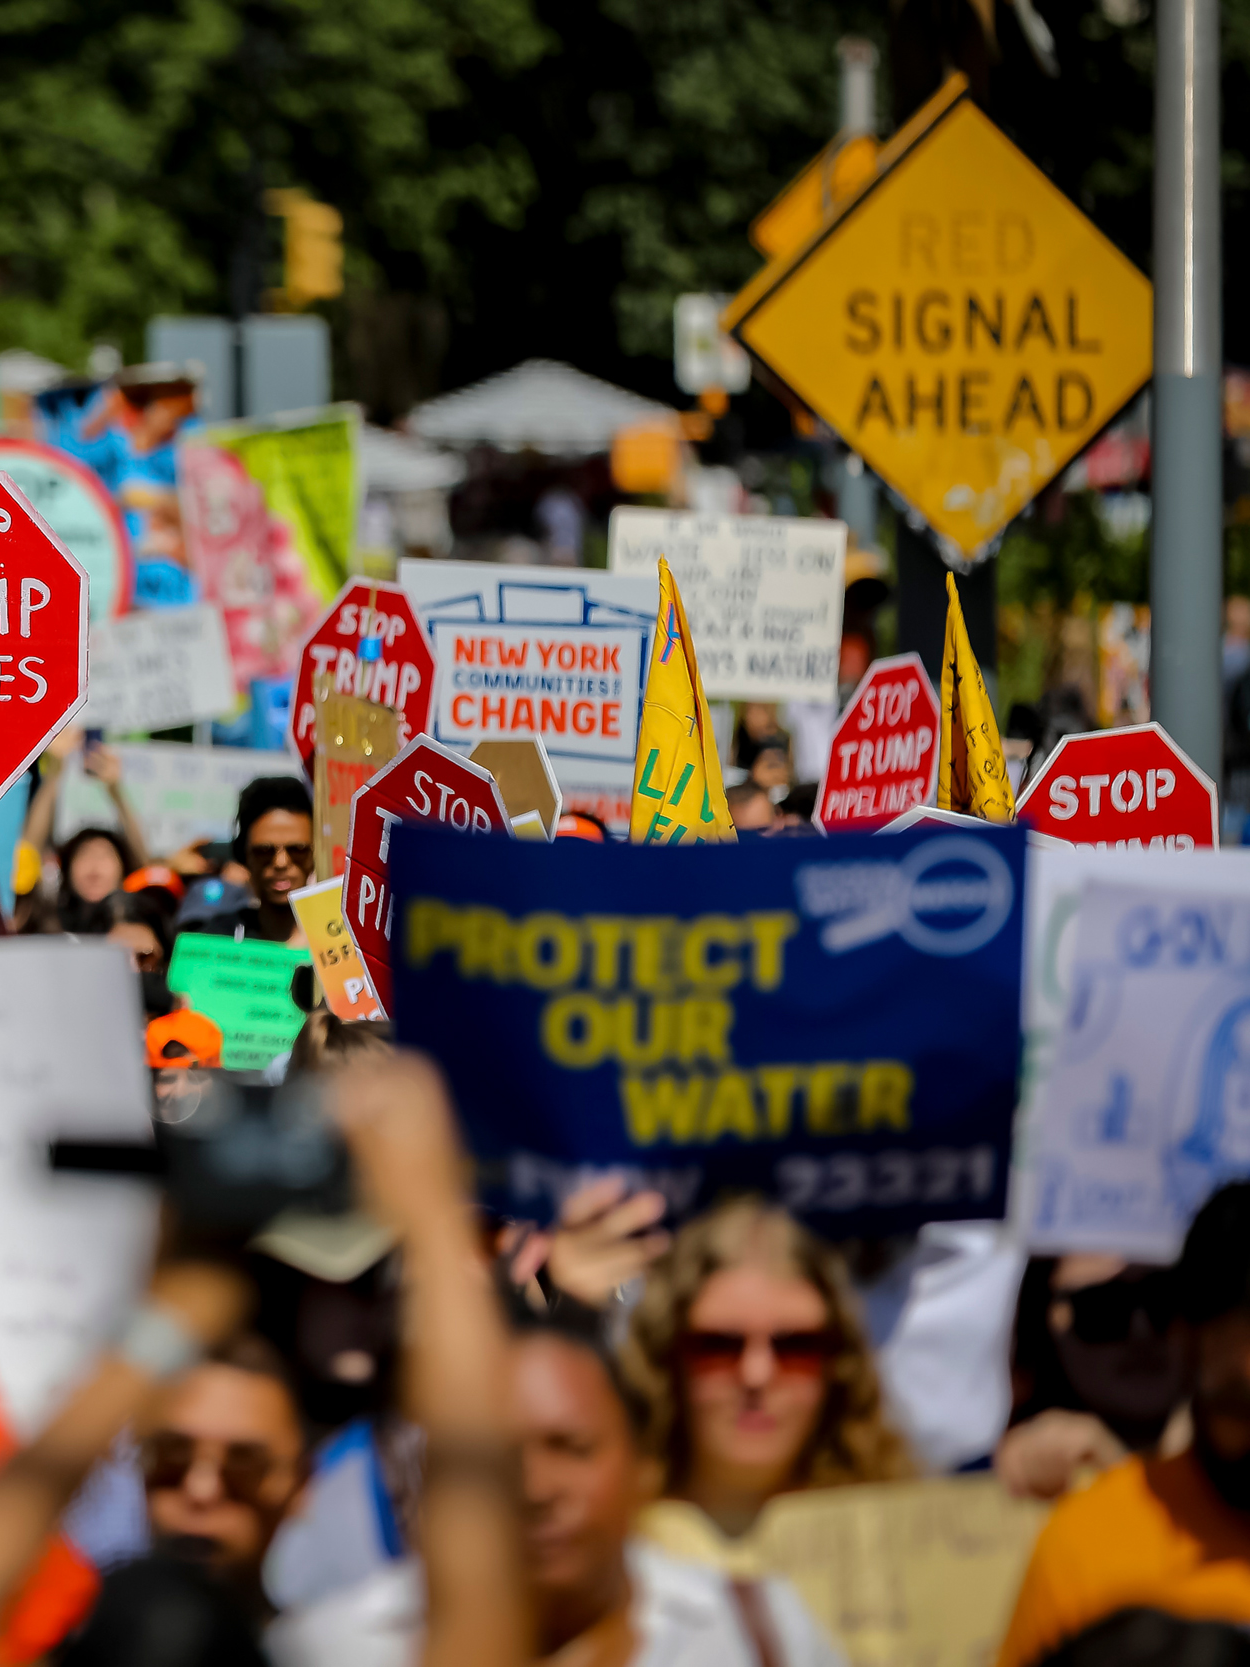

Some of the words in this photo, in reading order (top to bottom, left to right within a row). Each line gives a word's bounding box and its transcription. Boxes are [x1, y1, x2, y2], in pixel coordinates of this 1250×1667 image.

[899, 208, 1037, 278] RED
[844, 288, 1102, 356] SIGNAL
[857, 369, 1095, 434] AHEAD
[336, 603, 406, 647] STOP
[454, 635, 529, 668] NEW
[535, 639, 622, 673] YORK
[453, 671, 611, 695] COMMUNITIES
[857, 678, 920, 732] STOP
[451, 693, 622, 739] CHANGE
[838, 725, 933, 782] TRUMP
[406, 770, 492, 835] STOP
[824, 777, 926, 822] PIPELINES
[1049, 768, 1177, 821] STOP
[405, 898, 797, 989] PROTECT
[540, 993, 732, 1069] OUR
[622, 1060, 912, 1144] WATER
